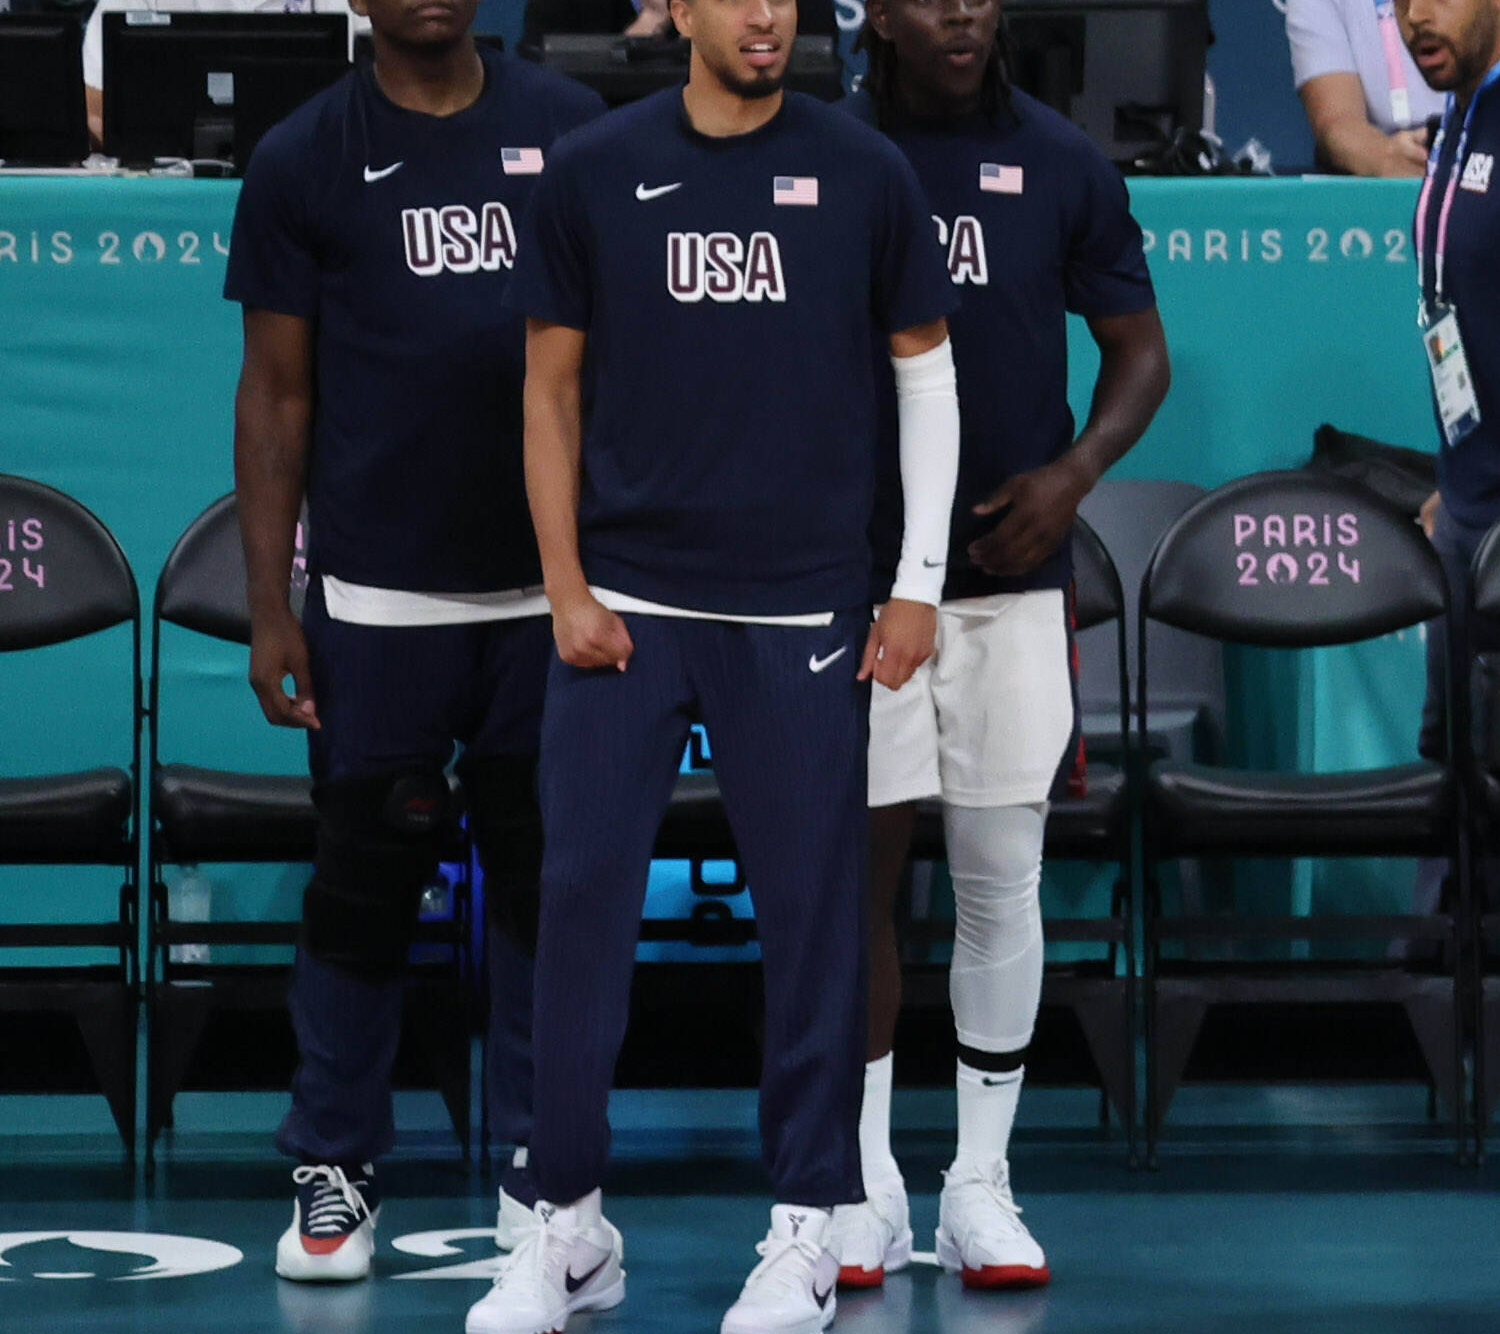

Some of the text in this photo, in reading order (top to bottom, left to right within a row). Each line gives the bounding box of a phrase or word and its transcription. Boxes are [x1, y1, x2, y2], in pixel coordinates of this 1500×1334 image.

[402, 203, 517, 277] USA
[667, 230, 786, 304] USA
[1237, 552, 1361, 587] 2024
